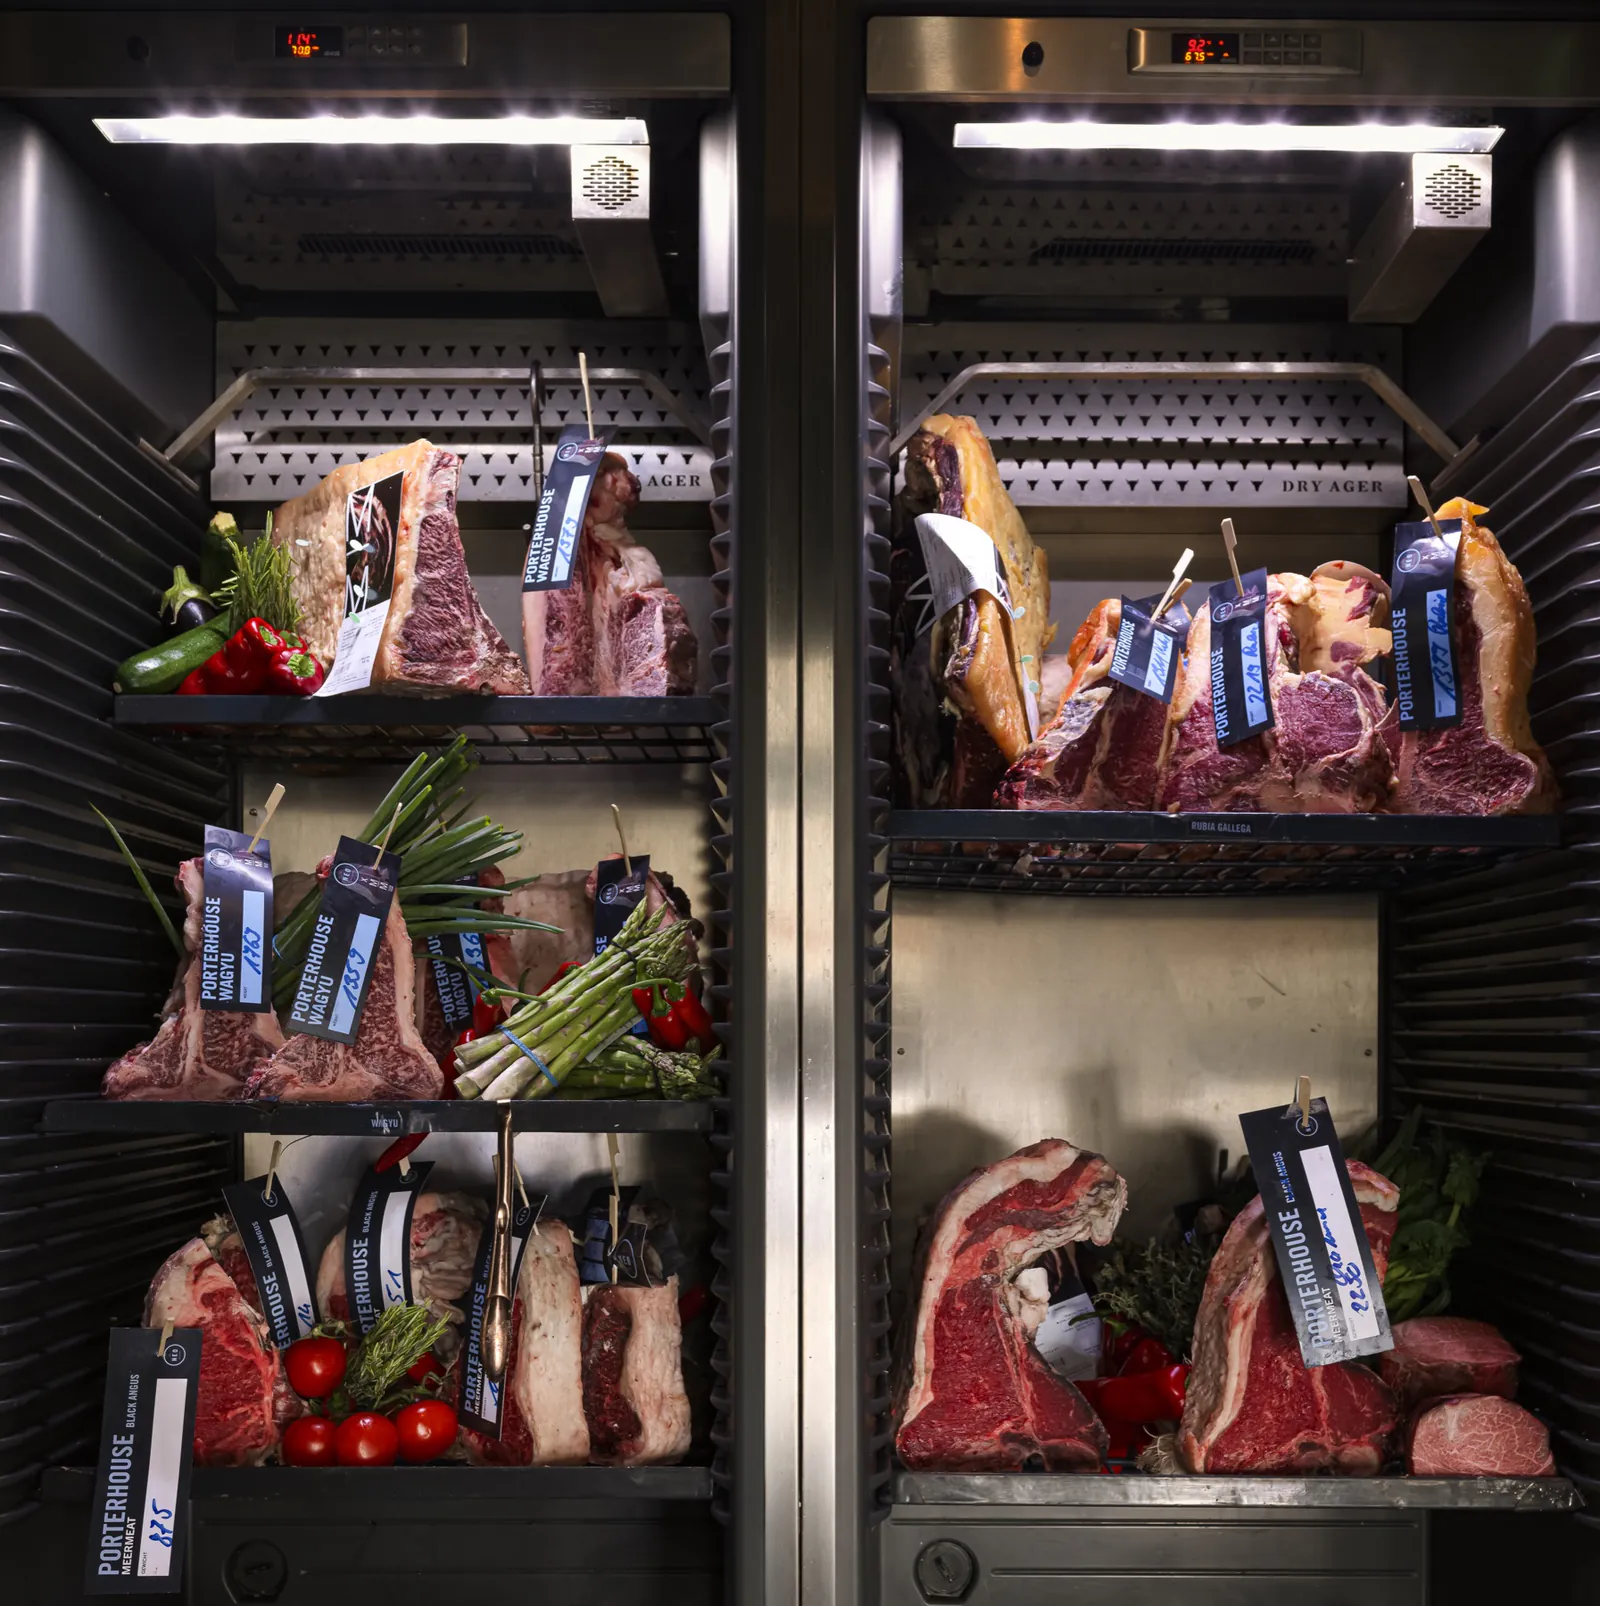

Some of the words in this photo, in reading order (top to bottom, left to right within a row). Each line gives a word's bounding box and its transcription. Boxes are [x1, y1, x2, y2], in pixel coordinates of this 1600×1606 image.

[647, 474, 701, 487] AGER
[1282, 479, 1323, 493] DRY
[1329, 479, 1383, 493] AGER
[524, 487, 556, 584] PORTERHOUSE
[535, 536, 555, 584] WAGYU
[1111, 618, 1136, 677] PORTERHOUSE
[1392, 607, 1415, 722] PORTERHOUSE
[1211, 646, 1230, 740] PORTERHOUSE
[1191, 821, 1216, 831] RUBIA
[1217, 823, 1252, 834] GALLEGA
[201, 896, 221, 1001] PORTERHOUSE
[291, 913, 335, 1023] PORTERHOUSE
[219, 952, 236, 1002] WAGYU
[307, 974, 335, 1026] WAGYU
[342, 947, 366, 1010] 1359
[449, 972, 471, 1020] WAGYU
[370, 1117, 399, 1129] WAGYU
[1272, 1150, 1289, 1180] ANGUS
[361, 1210, 373, 1234] BLACK
[365, 1189, 379, 1211] ANGUS
[251, 1220, 266, 1246] ANGUS
[260, 1243, 273, 1269] BLACK
[1277, 1207, 1332, 1349] PORTERHOUSE
[1345, 1261, 1370, 1317] 2250
[262, 1271, 293, 1351] ERHOUSE
[1320, 1287, 1344, 1344] MEERMEAT
[170, 1348, 178, 1362] NEO
[464, 1281, 487, 1414] PORTERHOUSE
[127, 1373, 140, 1401] ANGUS
[473, 1362, 484, 1416] MEERMEAT
[125, 1400, 137, 1428] BLACK
[98, 1433, 134, 1576] PORTERHOUSE
[148, 1497, 173, 1549] 875
[121, 1516, 137, 1575] MEERMEAT
